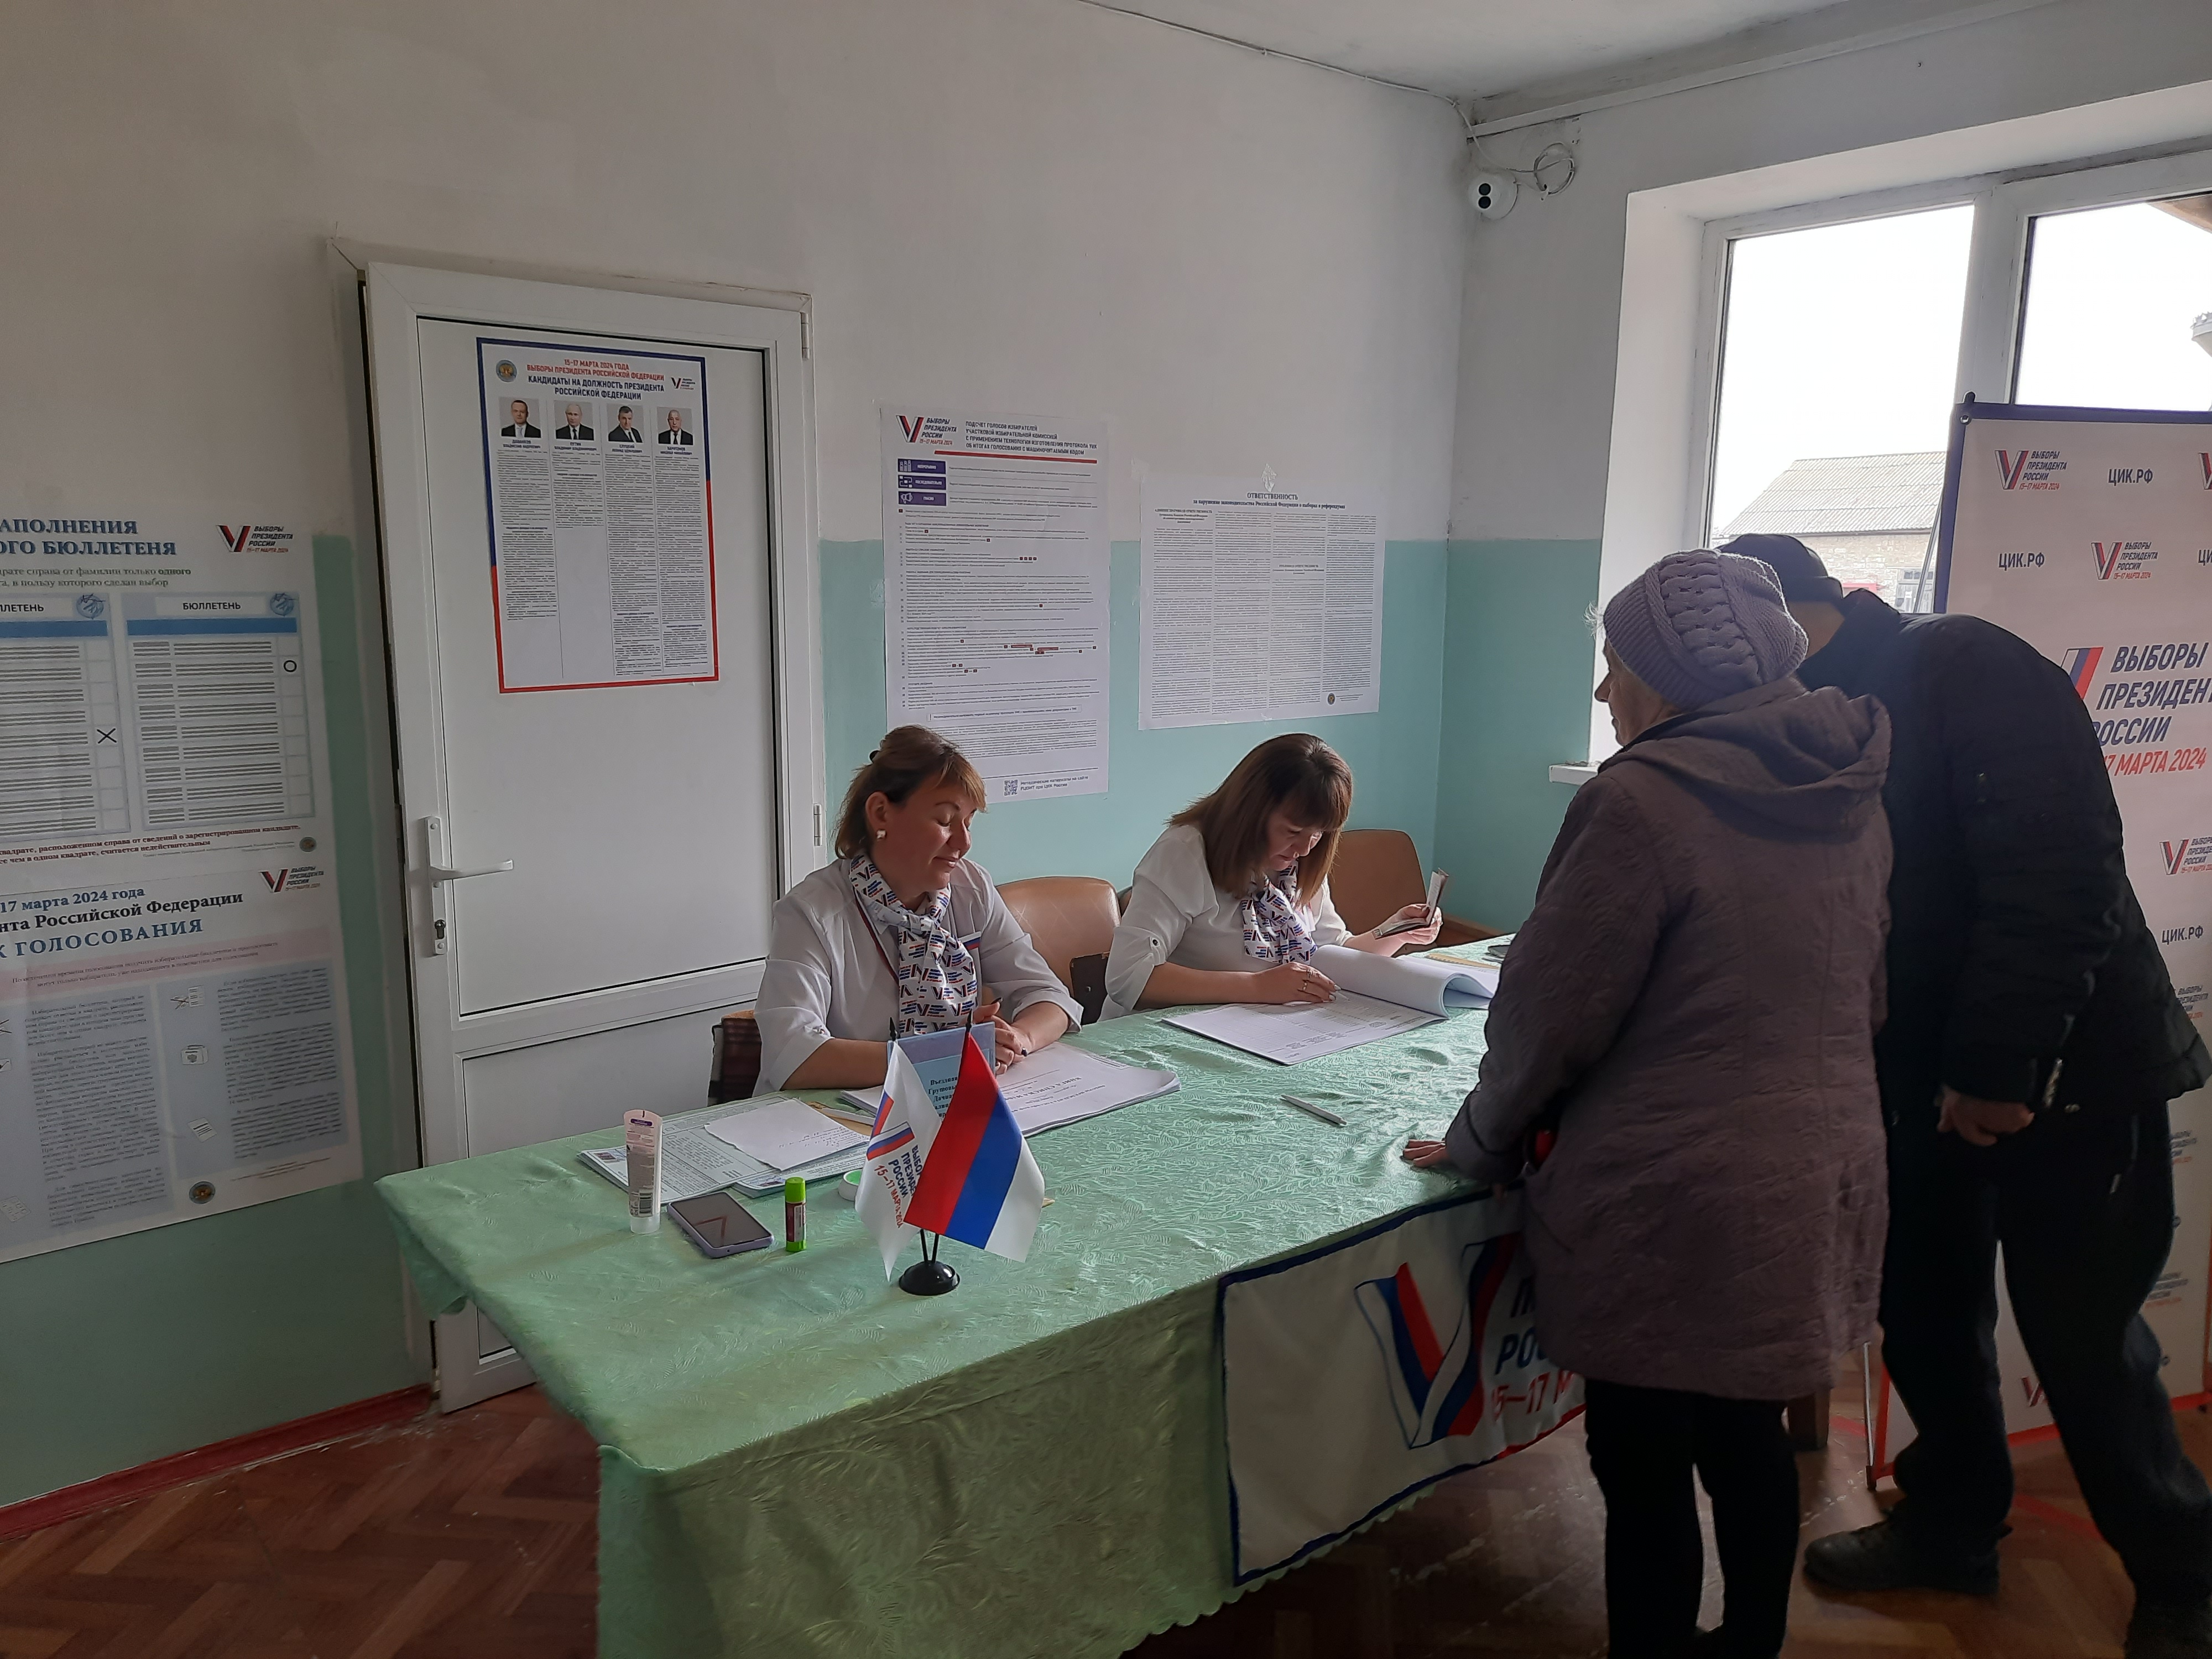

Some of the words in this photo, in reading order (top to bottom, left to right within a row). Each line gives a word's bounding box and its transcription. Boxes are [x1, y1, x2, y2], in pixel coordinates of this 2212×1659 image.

[527, 364, 554, 373] ВЫБОРЫ
[555, 367, 591, 375] ПРЕЗИДЕНТА
[593, 369, 630, 378] РОССИЙСКОЙ
[631, 372, 664, 381] ФЕДЕРАЦИИ
[528, 375, 570, 385] КАНДИДАТЫ
[582, 379, 623, 389] ДОЛЖНОСТЬ
[624, 383, 664, 392] ПРЕЗИДЕНТА
[555, 387, 600, 397] РОССИЙСКОЙ
[601, 390, 641, 400] ФЕДЕРАЦИИ
[2027, 462, 2067, 471] ПРЕЗИДЕНТА
[2022, 472, 2049, 481] РОССИИ
[2108, 468, 2153, 486] ЦИК.РФ
[41, 541, 176, 555] БЮЛЛЕТЕНЯ
[2120, 552, 2158, 560] ПРЕЗИДЕНТА
[1999, 552, 2045, 571] ЦИК.РФ
[27, 568, 60, 577] справа
[76, 567, 121, 576] фамилии
[139, 578, 168, 588] выбор
[183, 602, 241, 611] БЮЛЛЕТЕНЬ
[2110, 643, 2209, 673] ВЫБОРЫ
[2114, 750, 2168, 776] МАРТА
[2168, 748, 2206, 772] 2024
[39, 841, 102, 853] расположенном
[143, 834, 177, 843] сведений
[101, 847, 139, 855] считается
[140, 840, 211, 851] недействительным
[22, 898, 70, 911] марта
[72, 891, 108, 904] 2024
[111, 888, 146, 900] года
[35, 904, 142, 928] Российской
[146, 893, 244, 914] Федерации
[15, 919, 203, 957] ГОЛОСОВАНИЯ
[2162, 925, 2204, 944] ЦИК.РФ
[933, 1094, 952, 1103] Дачна
[888, 1159, 909, 1198] РОССИИ
[901, 1152, 916, 1196] ПРЕЗИДЕ
